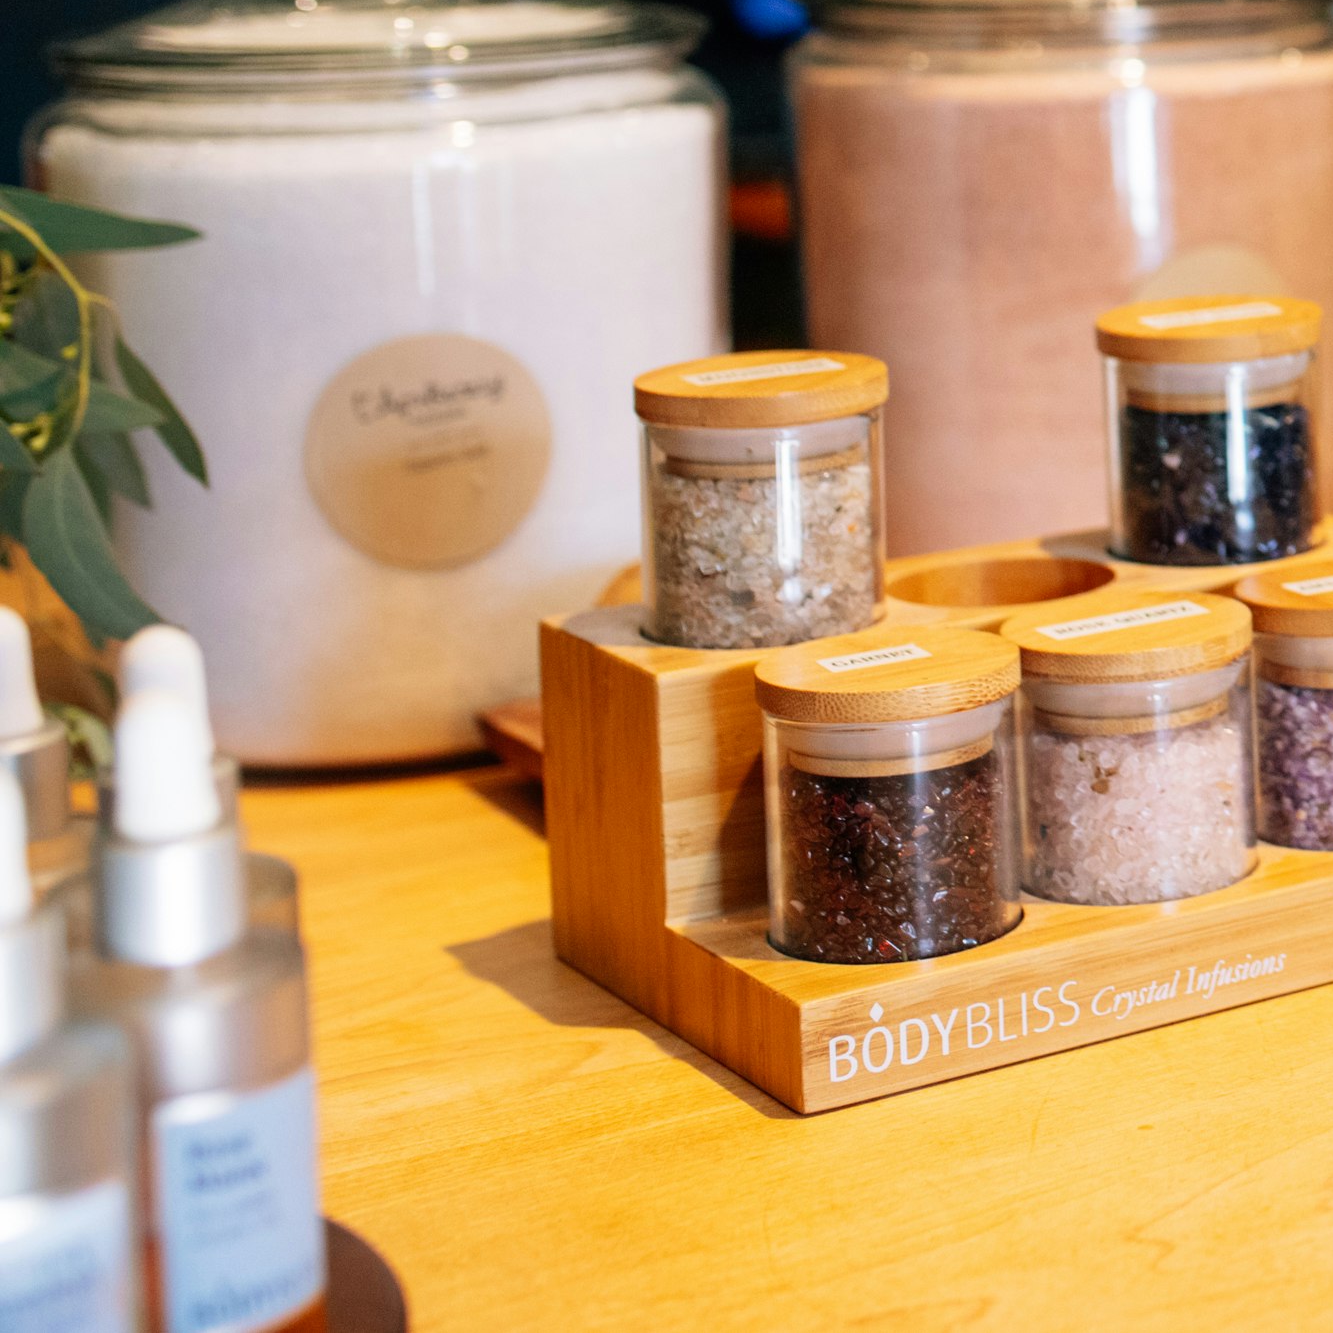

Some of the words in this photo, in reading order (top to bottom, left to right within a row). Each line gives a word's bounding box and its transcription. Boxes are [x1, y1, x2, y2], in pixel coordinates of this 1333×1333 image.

[830, 648, 914, 668] GARNET
[828, 980, 1081, 1083] BODYBLISS
[1090, 970, 1180, 1021] Crystal
[1184, 952, 1288, 1000] Infusions
